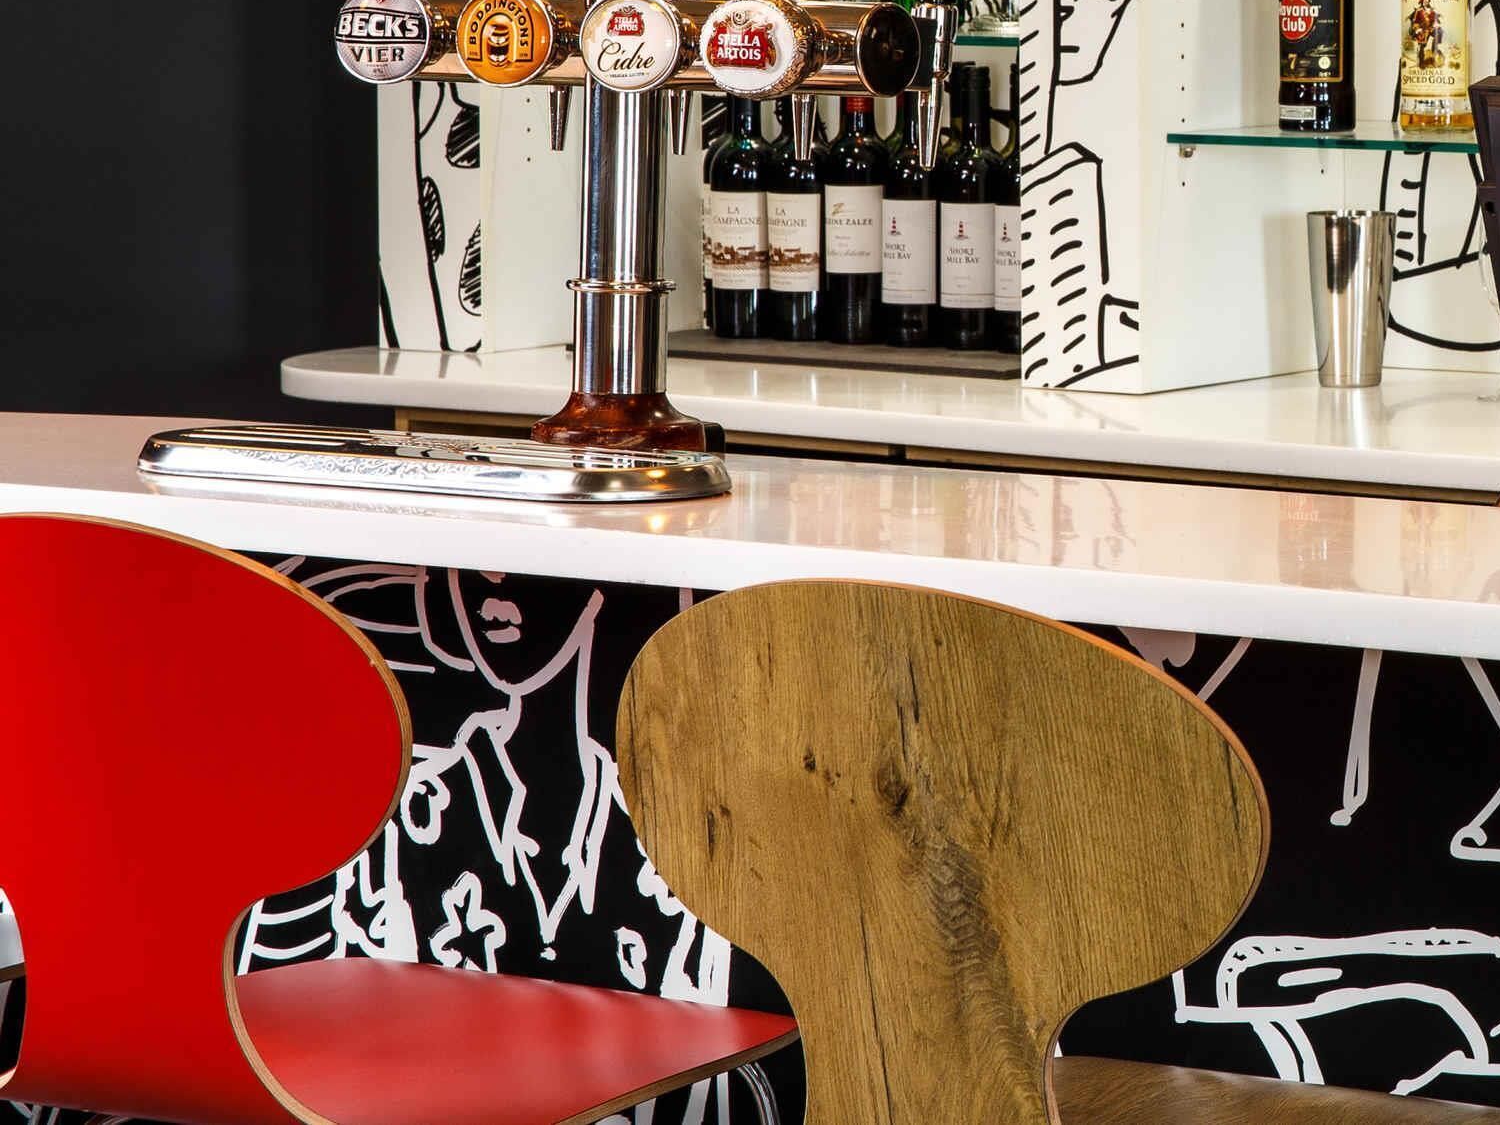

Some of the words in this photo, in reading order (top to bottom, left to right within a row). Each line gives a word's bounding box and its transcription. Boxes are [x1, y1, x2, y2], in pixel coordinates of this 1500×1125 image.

[1280, 5, 1319, 17] avana
[338, 12, 419, 37] BECK'S
[614, 16, 638, 24] STELLA
[1282, 18, 1306, 32] Club
[613, 24, 639, 32] ARTOIS
[717, 33, 761, 47] STELLA
[350, 47, 405, 63] VIER
[598, 38, 656, 73] Cidre
[716, 45, 762, 61] ARTOIS
[1288, 53, 1297, 70] 7
[1429, 75, 1456, 85] GOLD
[727, 206, 740, 214] LA
[775, 207, 787, 216] LA
[965, 256, 979, 264] BAY
